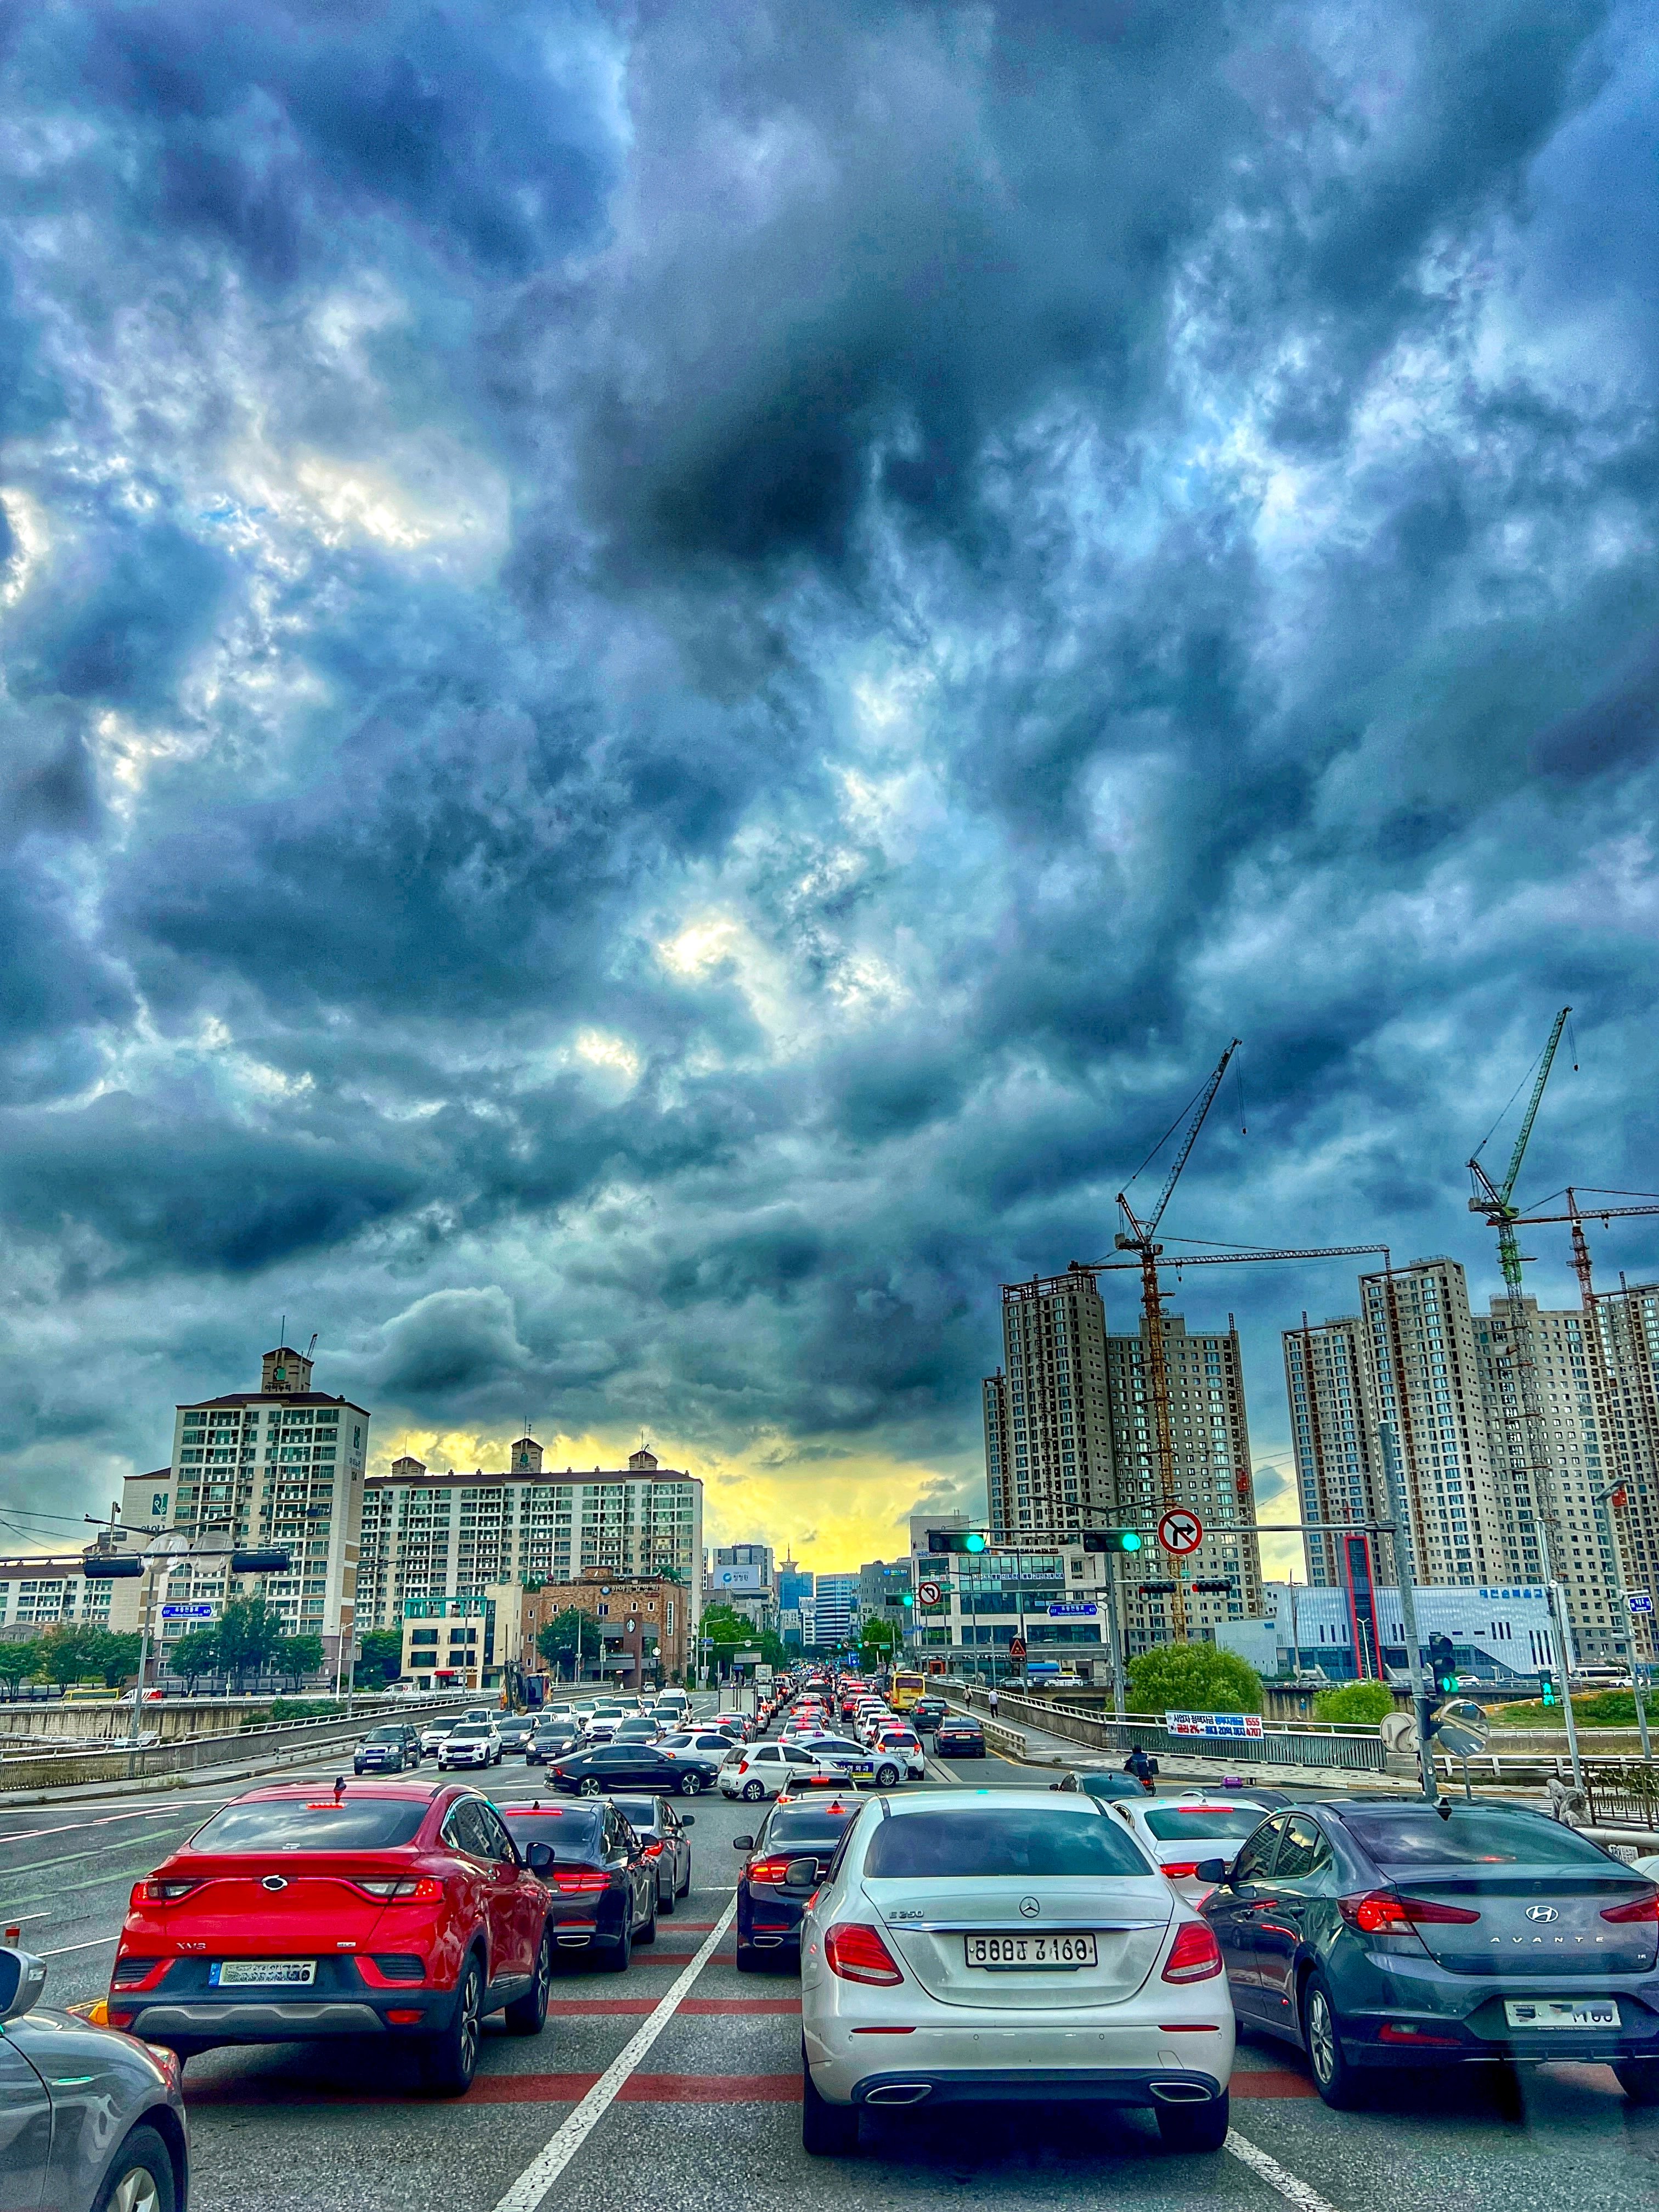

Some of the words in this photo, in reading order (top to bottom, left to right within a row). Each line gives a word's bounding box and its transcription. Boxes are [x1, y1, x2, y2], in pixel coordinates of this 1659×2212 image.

[1173, 1714, 1190, 1722] 사업자
[1191, 1715, 1214, 1724] 정책자금
[1245, 1717, 1260, 1726] 1555
[1177, 1724, 1189, 1733] 금리
[1246, 1728, 1261, 1737] 4707
[899, 1910, 924, 1918] 250
